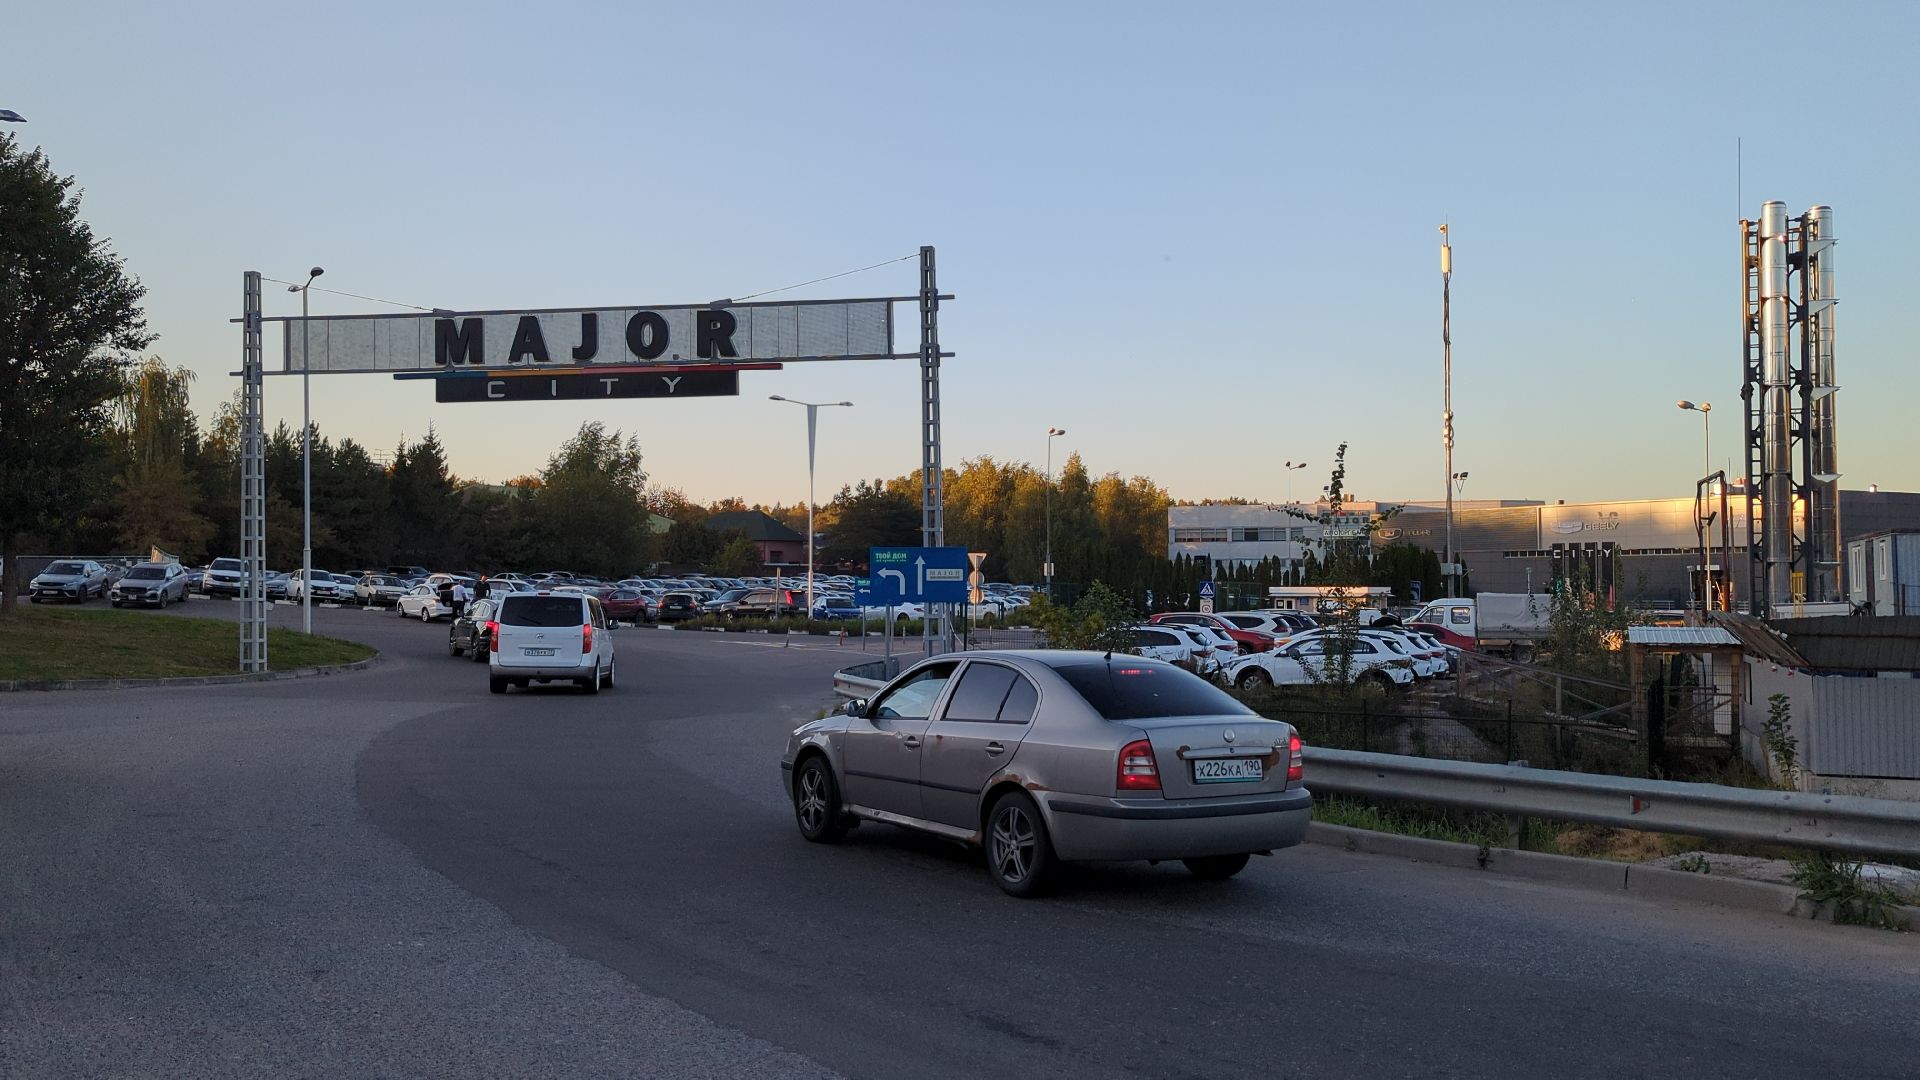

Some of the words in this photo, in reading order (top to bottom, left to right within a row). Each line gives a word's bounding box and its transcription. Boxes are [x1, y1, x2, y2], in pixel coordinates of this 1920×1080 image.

[435, 309, 740, 365] MAJOR
[487, 376, 682, 399] CITY
[1584, 522, 1620, 531] GEELY
[875, 552, 891, 560] ТВОЙ
[892, 552, 907, 560] ДОМ
[1553, 549, 1612, 559] CITY
